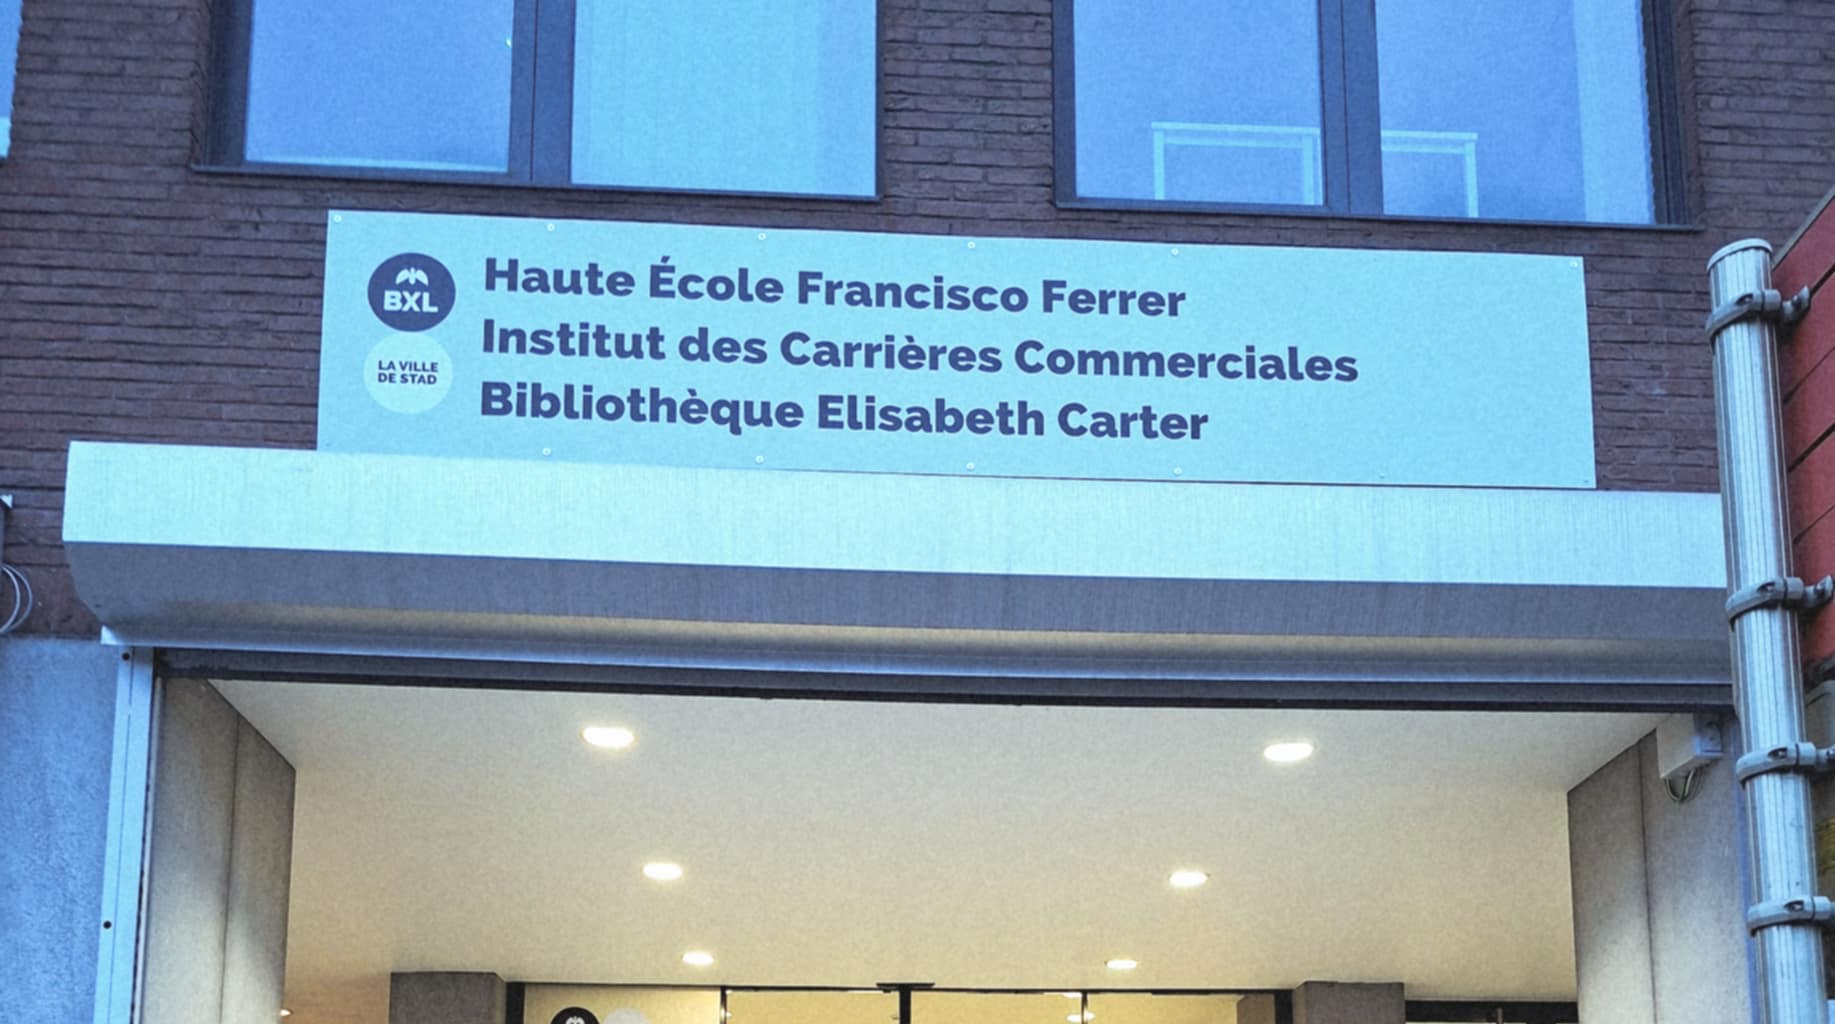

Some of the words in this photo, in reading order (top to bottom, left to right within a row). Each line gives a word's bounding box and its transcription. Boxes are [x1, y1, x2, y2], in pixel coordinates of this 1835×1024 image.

[383, 290, 439, 313] BXL
[485, 257, 636, 297] Haute
[649, 255, 785, 304] École
[797, 270, 1029, 313] Francisco
[1042, 279, 1187, 317] Ferrer
[378, 360, 395, 371] LA
[398, 361, 439, 372] VILLE
[482, 318, 666, 361] Institut
[678, 326, 768, 365] des
[780, 331, 1003, 373] Carrières
[1014, 339, 1359, 383] Commerciales
[377, 372, 396, 384] DE
[399, 373, 438, 385] STAD
[480, 380, 805, 436] Bibliothèque
[817, 394, 1045, 437] Elisabeth
[1057, 402, 1209, 440] Carter
